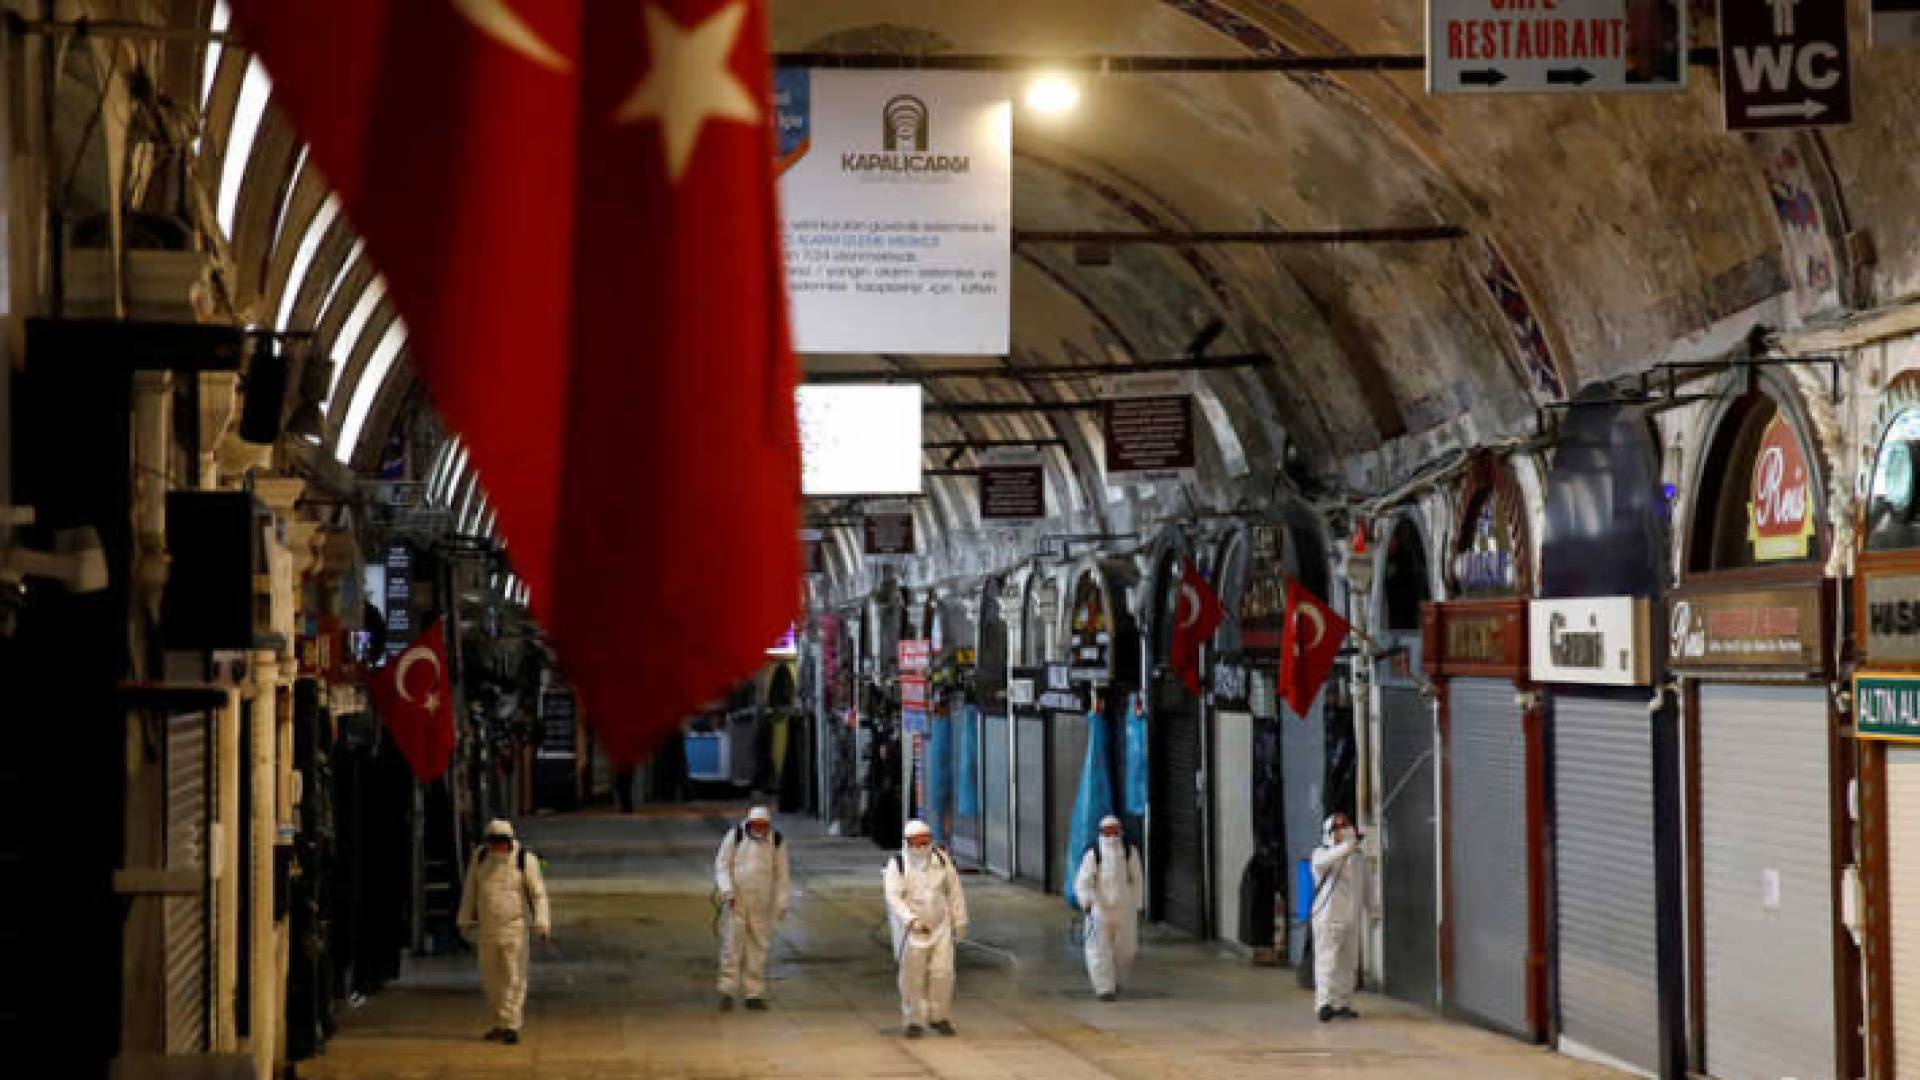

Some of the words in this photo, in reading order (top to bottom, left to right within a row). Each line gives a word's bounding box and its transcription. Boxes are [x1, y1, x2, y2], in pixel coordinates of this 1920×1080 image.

[1447, 18, 1625, 60] RESTAURANT
[1732, 41, 1841, 94] WC
[1860, 687, 1897, 725] ALTIN
